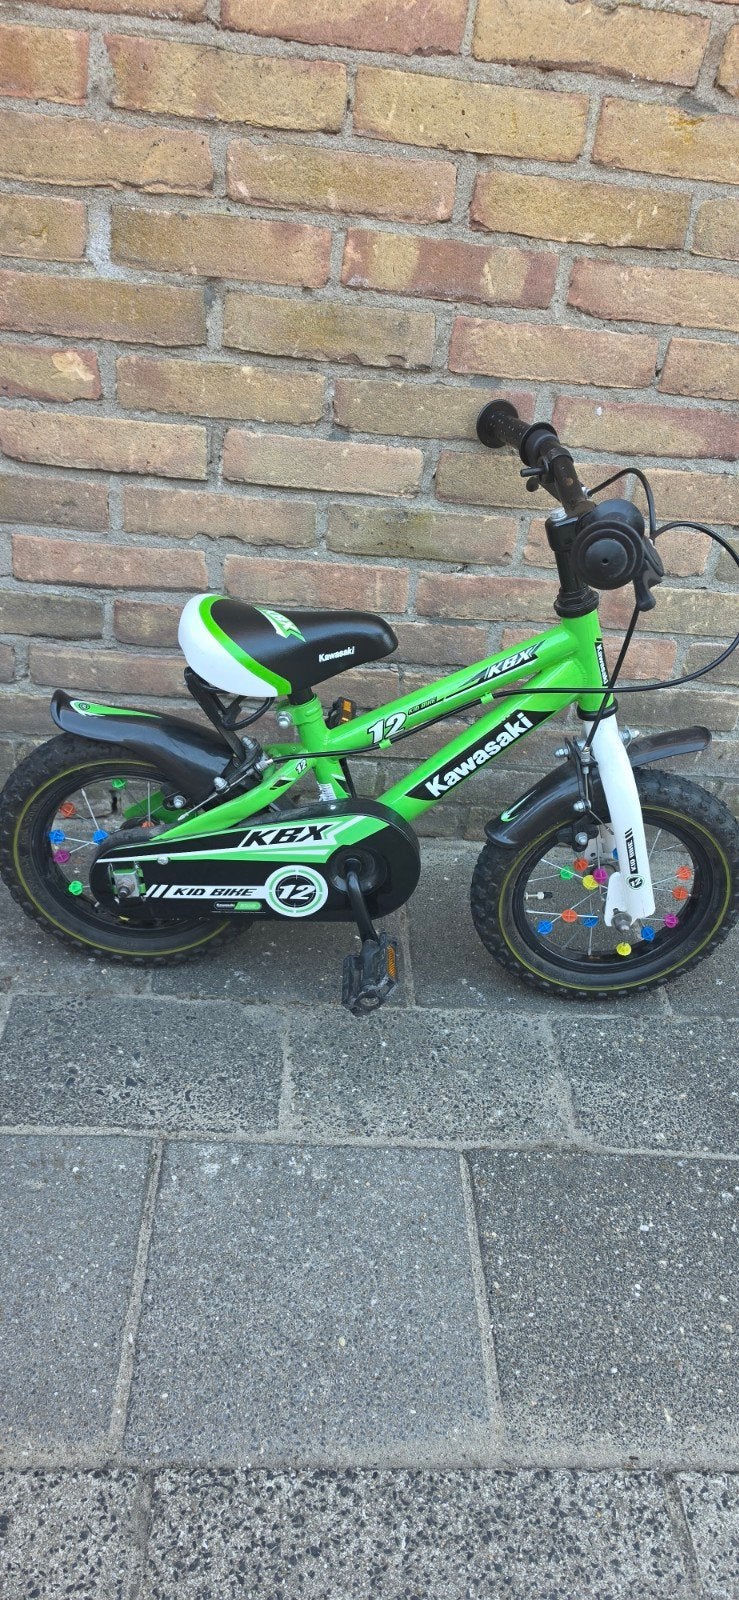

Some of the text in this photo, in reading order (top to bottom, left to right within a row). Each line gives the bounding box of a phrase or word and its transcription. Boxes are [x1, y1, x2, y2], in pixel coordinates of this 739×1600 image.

[318, 645, 355, 662] Kawasaki
[487, 646, 534, 678] KBX
[367, 712, 408, 744] 12
[425, 712, 533, 797] Kawasaki
[241, 824, 332, 848] KBX
[172, 887, 258, 897] KID BIKE
[278, 884, 316, 900] 12
